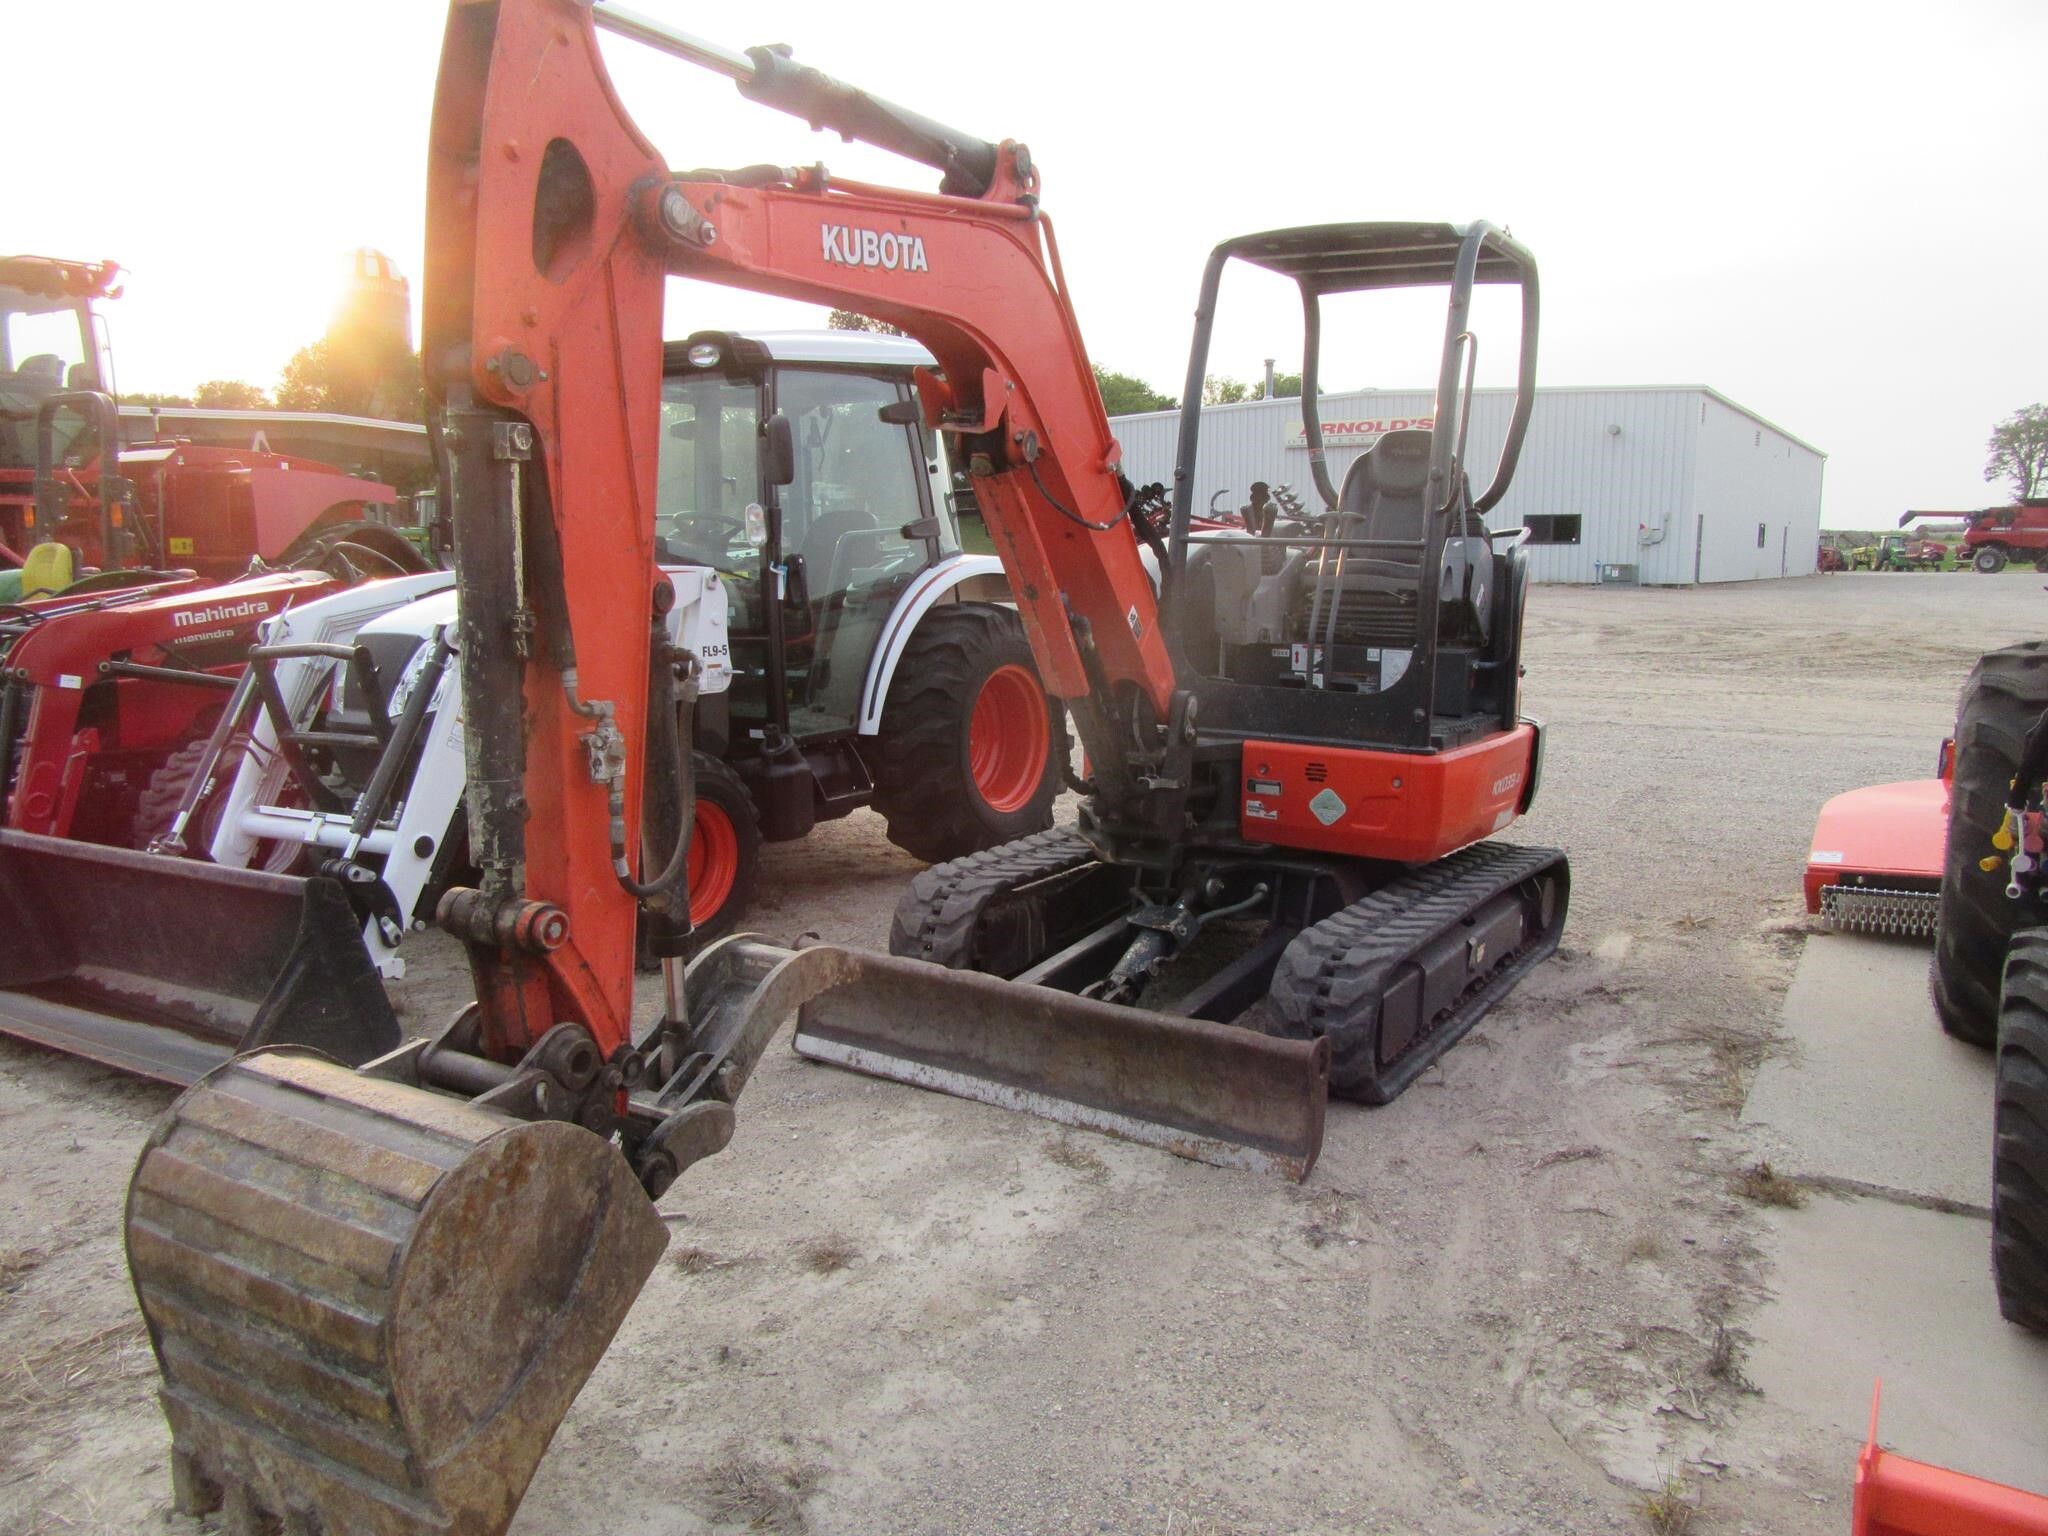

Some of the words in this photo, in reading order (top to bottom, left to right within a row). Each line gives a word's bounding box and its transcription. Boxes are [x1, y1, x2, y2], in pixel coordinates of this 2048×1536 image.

[821, 223, 929, 272] KUBOTA
[1300, 418, 1434, 436] RNOLD'S
[174, 601, 270, 627] Mahindra
[702, 644, 728, 657] FL9-5
